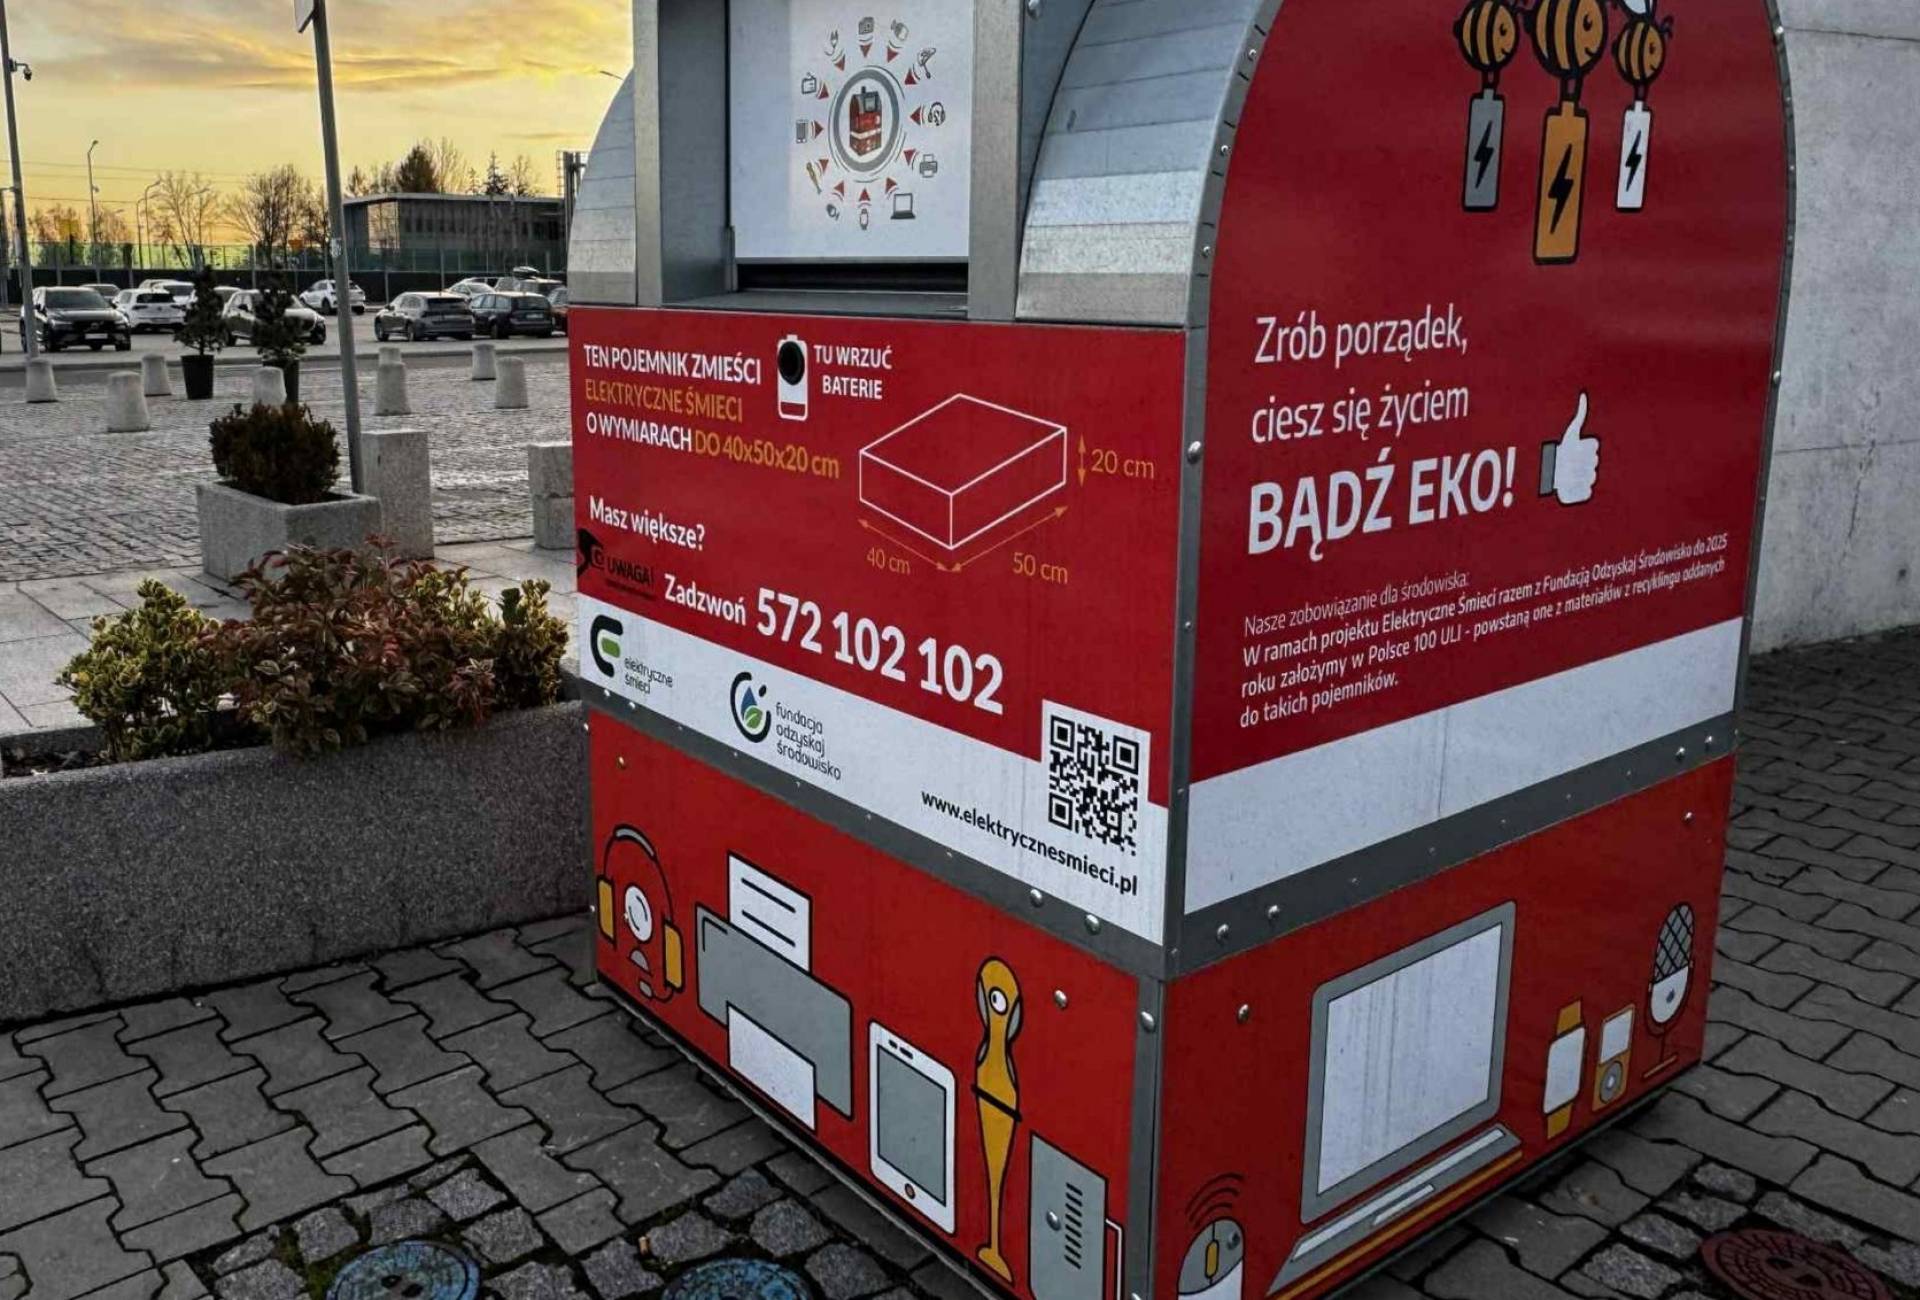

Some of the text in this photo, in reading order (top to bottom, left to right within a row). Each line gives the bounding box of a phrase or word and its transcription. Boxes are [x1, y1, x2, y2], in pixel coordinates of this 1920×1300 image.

[814, 345, 893, 369] TU WRZUĆ
[1254, 303, 1468, 369] Zrób porządek,
[584, 344, 761, 385] TEN POJEMNIK ZMIEŚCI
[585, 378, 743, 422] ELEKTRYCZNE ŚMIECI
[822, 376, 883, 399] BATERIE
[1252, 380, 1469, 443] ciesz się życiem
[586, 413, 840, 479] O WYMIARACH DO 40x50x20 cm
[1091, 448, 1155, 479] 20 cm
[590, 495, 705, 551] Masz większe?
[1248, 447, 1517, 562] BĄDŹ EKO!
[866, 547, 911, 575] 40 cm
[1013, 552, 1068, 584] 50 cm
[1243, 532, 1728, 667] W ramach projektu Elektryczne Śmieci razem z Fundacją Odzyskaj Środowisko do 2025
[1244, 612, 1285, 637] Nasze
[1289, 591, 1377, 627] zobowiązanie
[1379, 586, 1398, 606] dla
[664, 573, 1004, 715] Zadzwoń 572 102 102
[1241, 675, 1276, 699] roku
[1280, 655, 1348, 688] założymy
[1352, 652, 1364, 669] w
[1368, 640, 1410, 666] Polsce
[1414, 631, 1437, 652] 100
[1440, 626, 1461, 646] ULI
[1474, 609, 1529, 642] powstaną
[1533, 604, 1553, 621] one
[1556, 603, 1563, 616] z
[1564, 586, 1622, 612] materiałów
[1624, 586, 1631, 597] z
[1632, 571, 1681, 597] recyklingu
[1682, 558, 1725, 583] oddanych
[624, 656, 673, 689] elektryczne
[625, 673, 651, 694] śmieci
[776, 701, 823, 734] fundacja
[1240, 671, 1399, 728] do takich pojemników.
[776, 724, 825, 757] odzyskaj
[776, 742, 842, 781] środowisko
[921, 790, 1138, 896] www.elektrycznesmieci.pl
